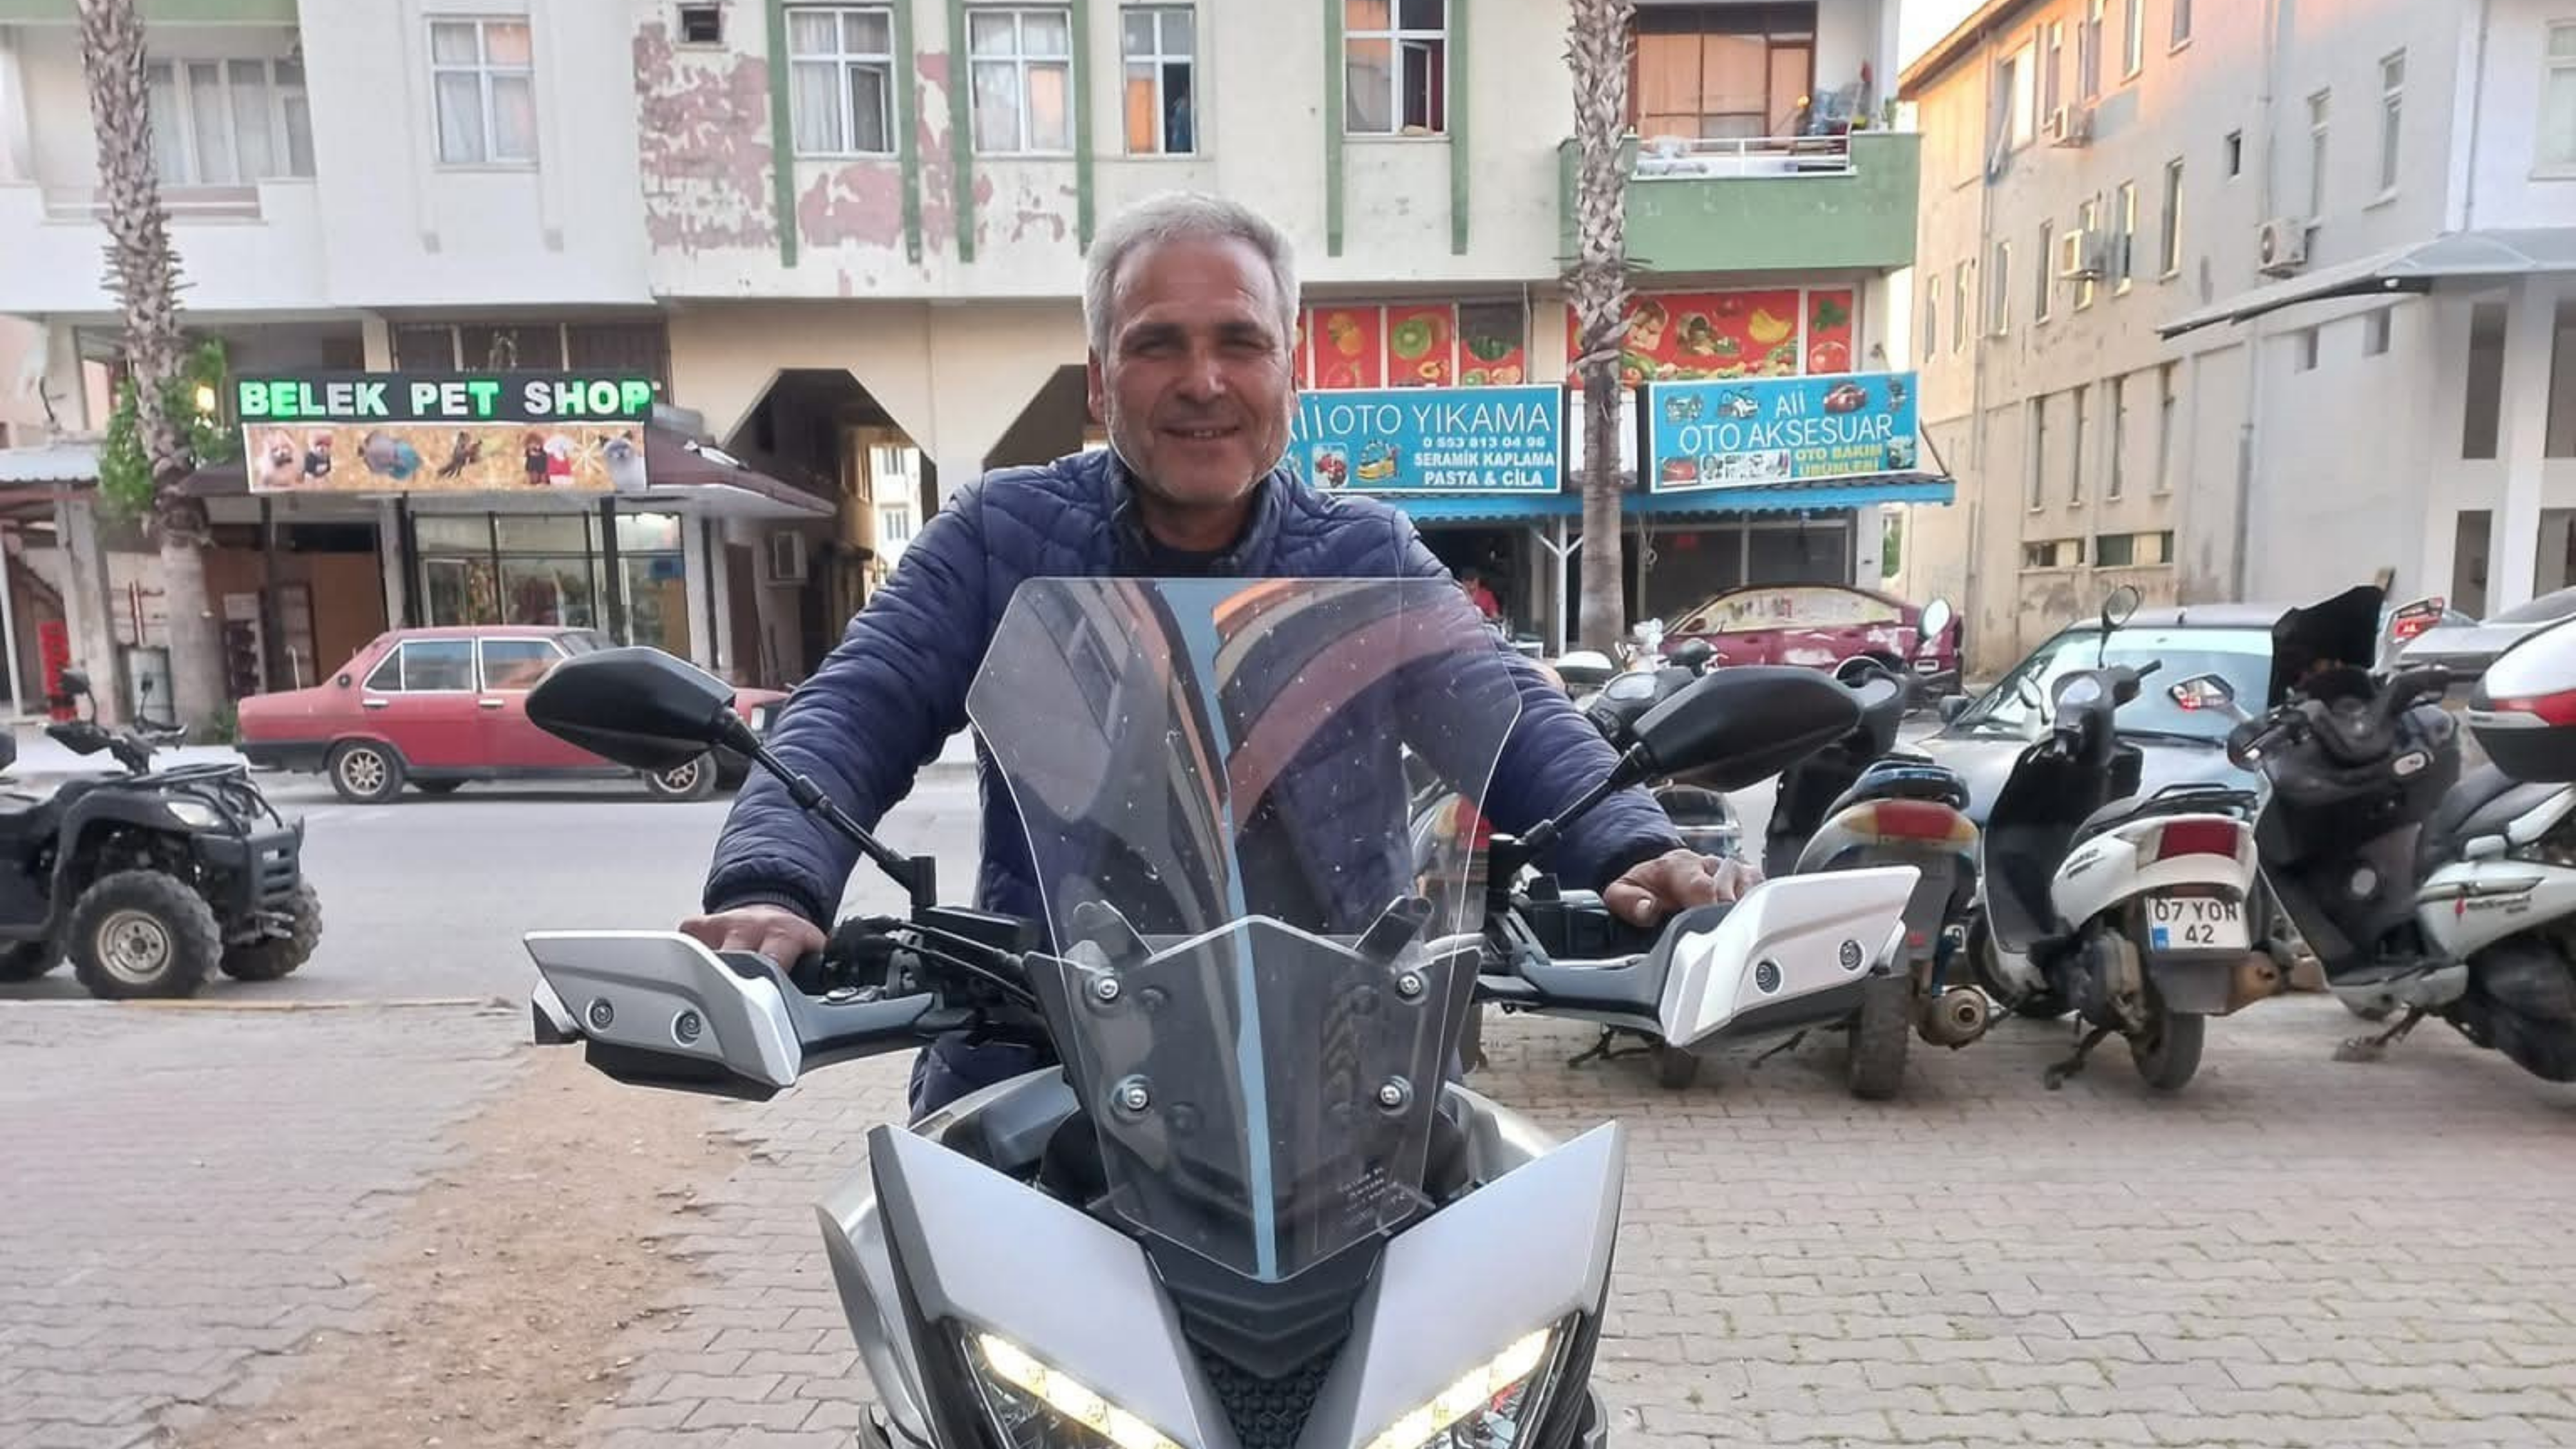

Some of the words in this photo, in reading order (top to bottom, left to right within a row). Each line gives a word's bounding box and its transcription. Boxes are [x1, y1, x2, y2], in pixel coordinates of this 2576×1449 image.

[240, 381, 389, 416] BELEK
[411, 381, 500, 415] PET
[524, 381, 652, 415] SHOP
[1329, 404, 1401, 435] OTO
[1412, 402, 1551, 434] YIKAMA
[1423, 436, 1432, 448] 0
[1502, 436, 1521, 448] 04
[1678, 422, 1741, 455] OTO
[1748, 413, 1893, 449] AKSESUAR
[1414, 449, 1479, 467] SERAMİK
[1483, 451, 1555, 467] KAPLAMA
[1795, 446, 1827, 462] OTO
[1425, 470, 1478, 486] PASTA
[1484, 470, 1497, 485] &
[2155, 900, 2183, 921] 07
[2184, 924, 2214, 944] 42
